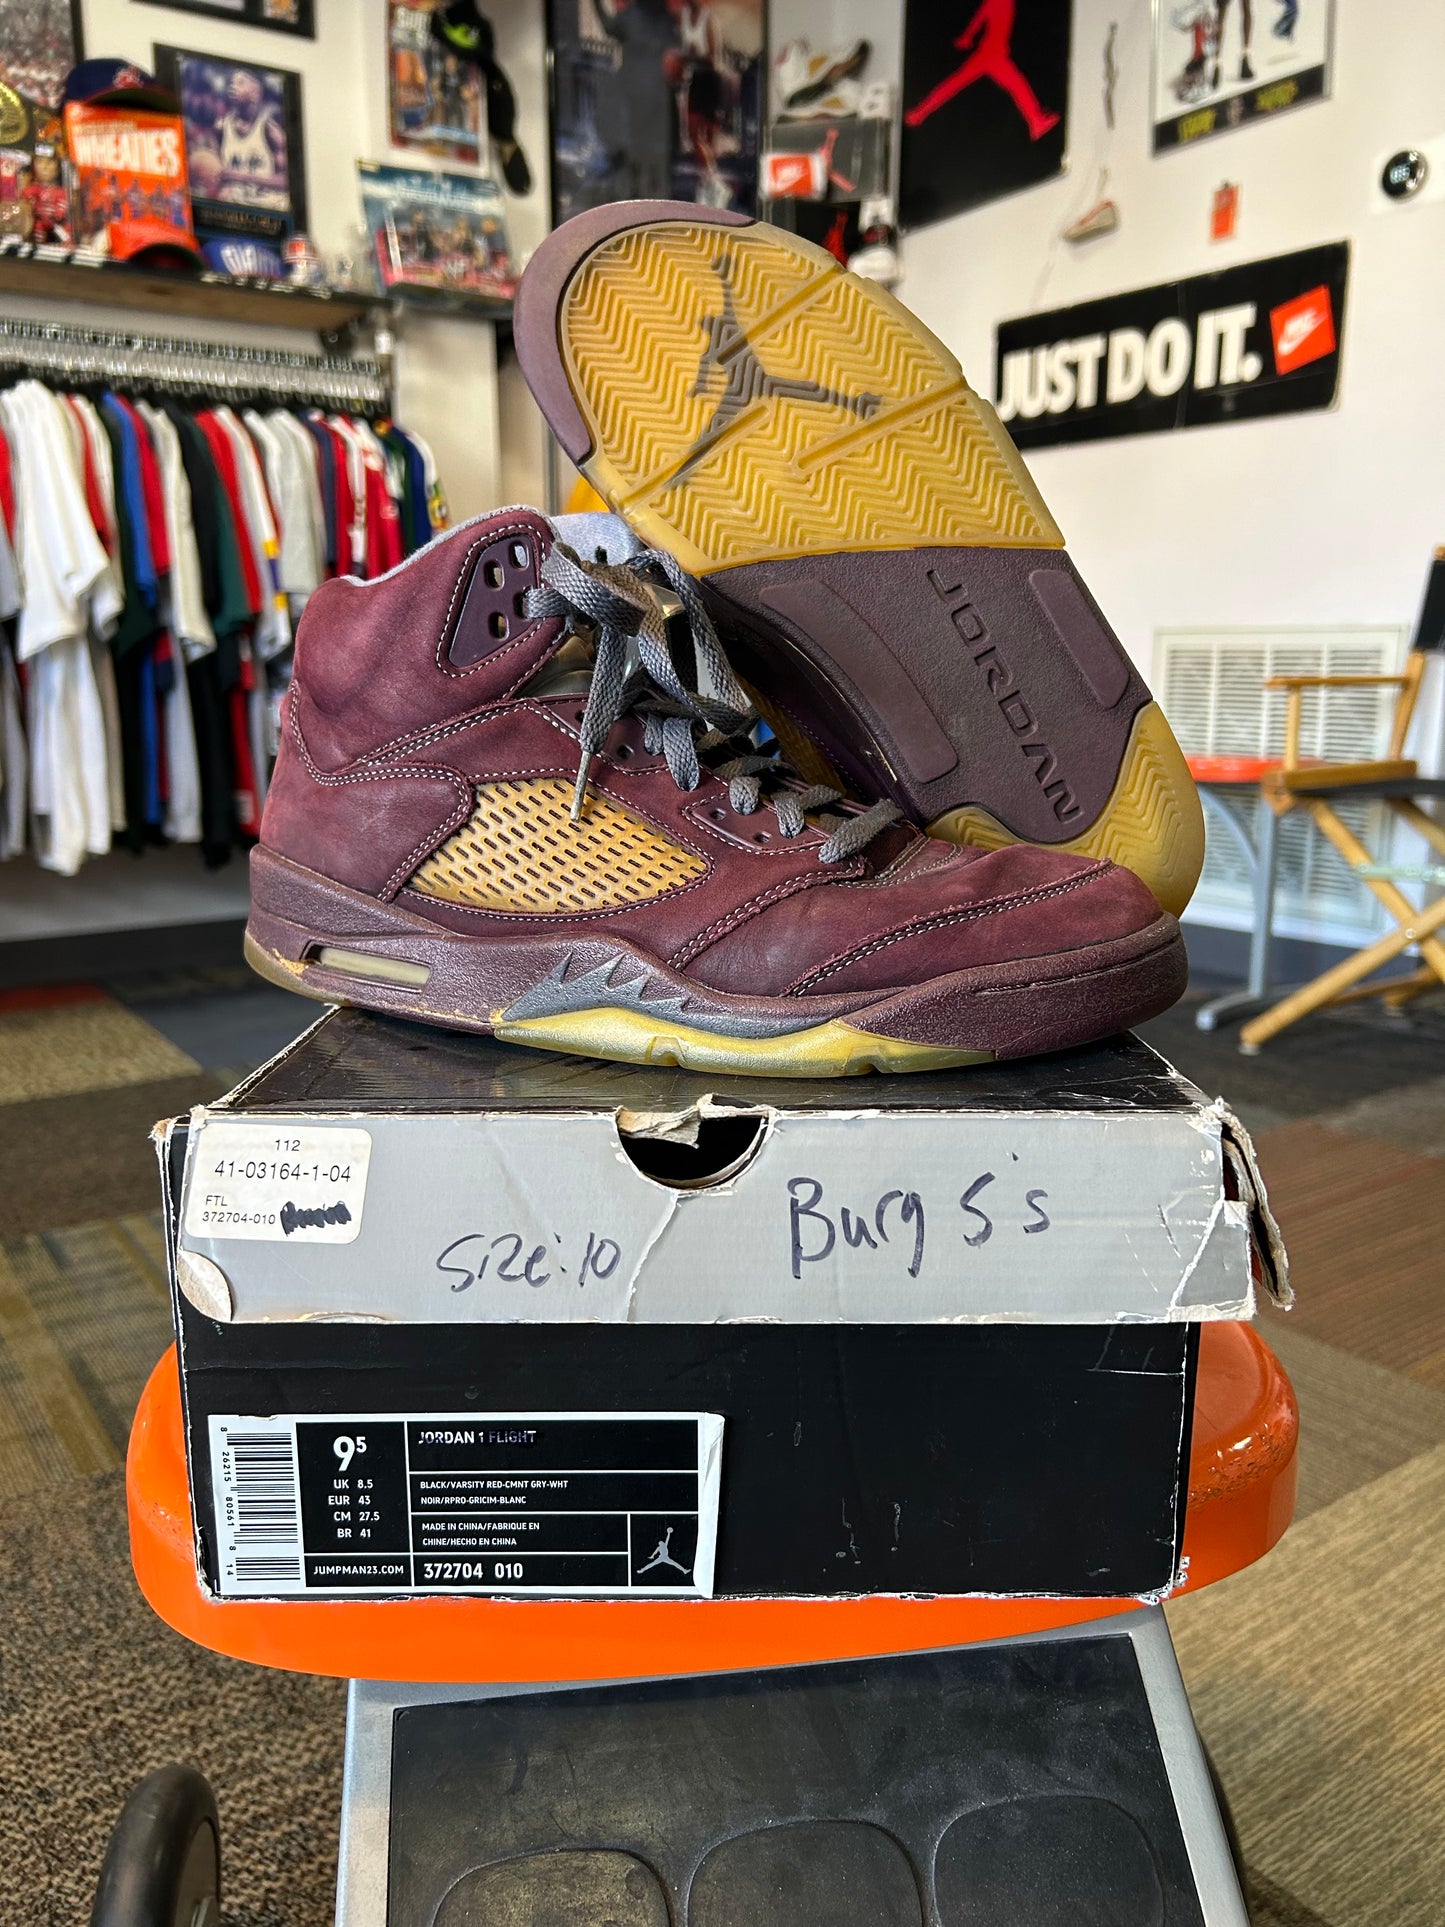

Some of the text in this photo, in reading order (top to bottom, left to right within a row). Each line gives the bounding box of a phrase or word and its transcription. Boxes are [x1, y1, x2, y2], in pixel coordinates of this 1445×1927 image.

[73, 128, 180, 178] WHEATIES
[998, 301, 1264, 423] JUST DO IT.
[927, 569, 1085, 825] JORDAN
[274, 1139, 301, 1152] 112
[214, 1160, 352, 1183] 41-03164-1-04
[205, 1195, 228, 1207] FTL
[202, 1211, 276, 1225] 372704-010
[787, 1176, 925, 1279] Burg
[418, 1431, 475, 1444] JORDAN
[488, 1430, 537, 1443] FLIGHT
[222, 1451, 231, 1482] 26215
[333, 1479, 374, 1489] UK 8.5
[420, 1480, 569, 1490] BLACK/VARSITY RED-CMNT GRY-WHT
[328, 1495, 371, 1505] EUR 43
[420, 1496, 527, 1505] NOIR/RPRO-GRICIM-BLANC
[225, 1496, 235, 1527] 80561
[333, 1511, 380, 1521] CM 27.5
[337, 1528, 371, 1538] BR 41
[422, 1522, 540, 1531] MADE IN CHINA/FABRIQUE EN
[422, 1537, 518, 1546] CHINE/HECHO EN CHINA
[313, 1565, 404, 1575] JUMPMAN23.COM
[423, 1563, 524, 1579] 372704 010
